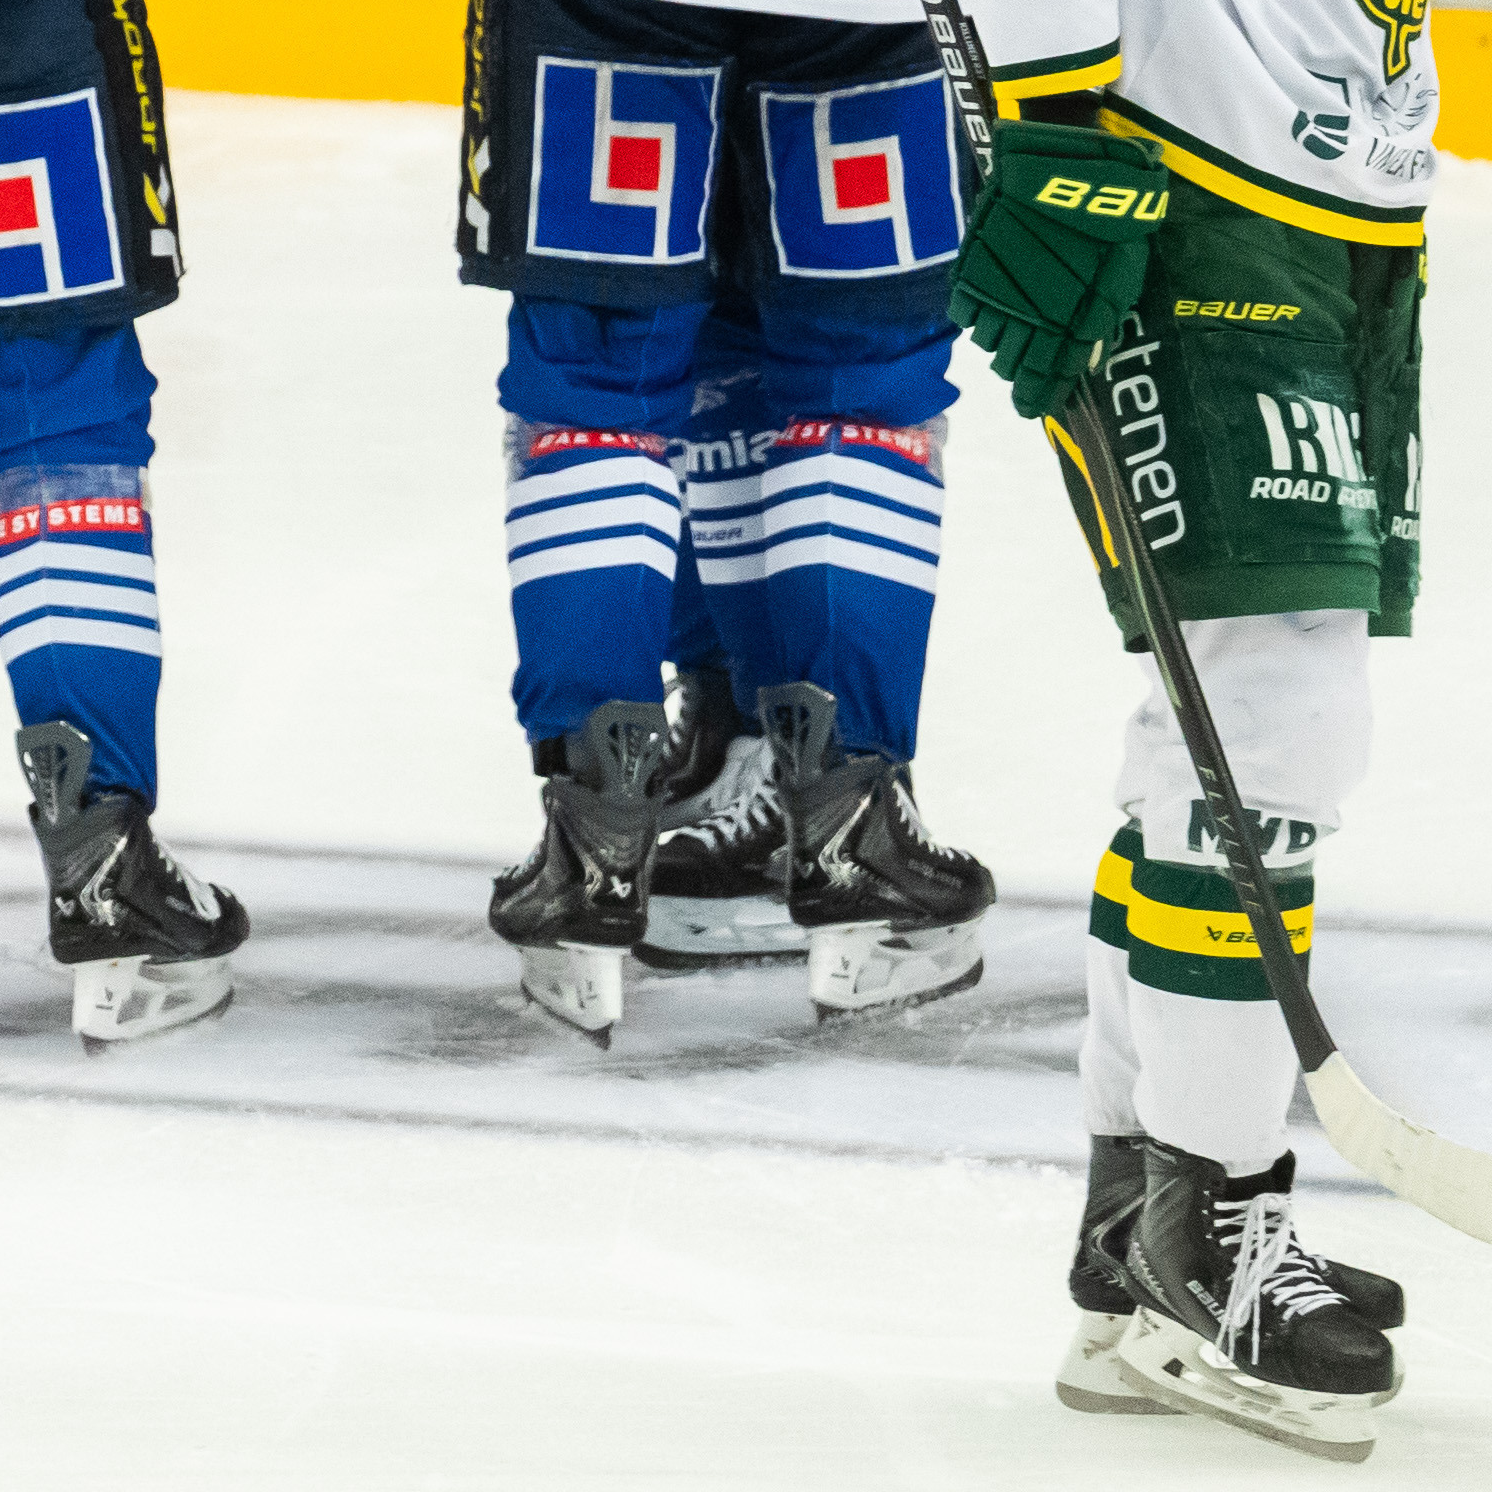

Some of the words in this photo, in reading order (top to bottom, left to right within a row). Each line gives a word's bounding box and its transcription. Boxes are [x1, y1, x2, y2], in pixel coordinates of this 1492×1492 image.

[1036, 176, 1168, 222] BAU
[1173, 299, 1301, 322] BAUER
[687, 428, 776, 474] mia
[1250, 476, 1332, 504] ROAD
